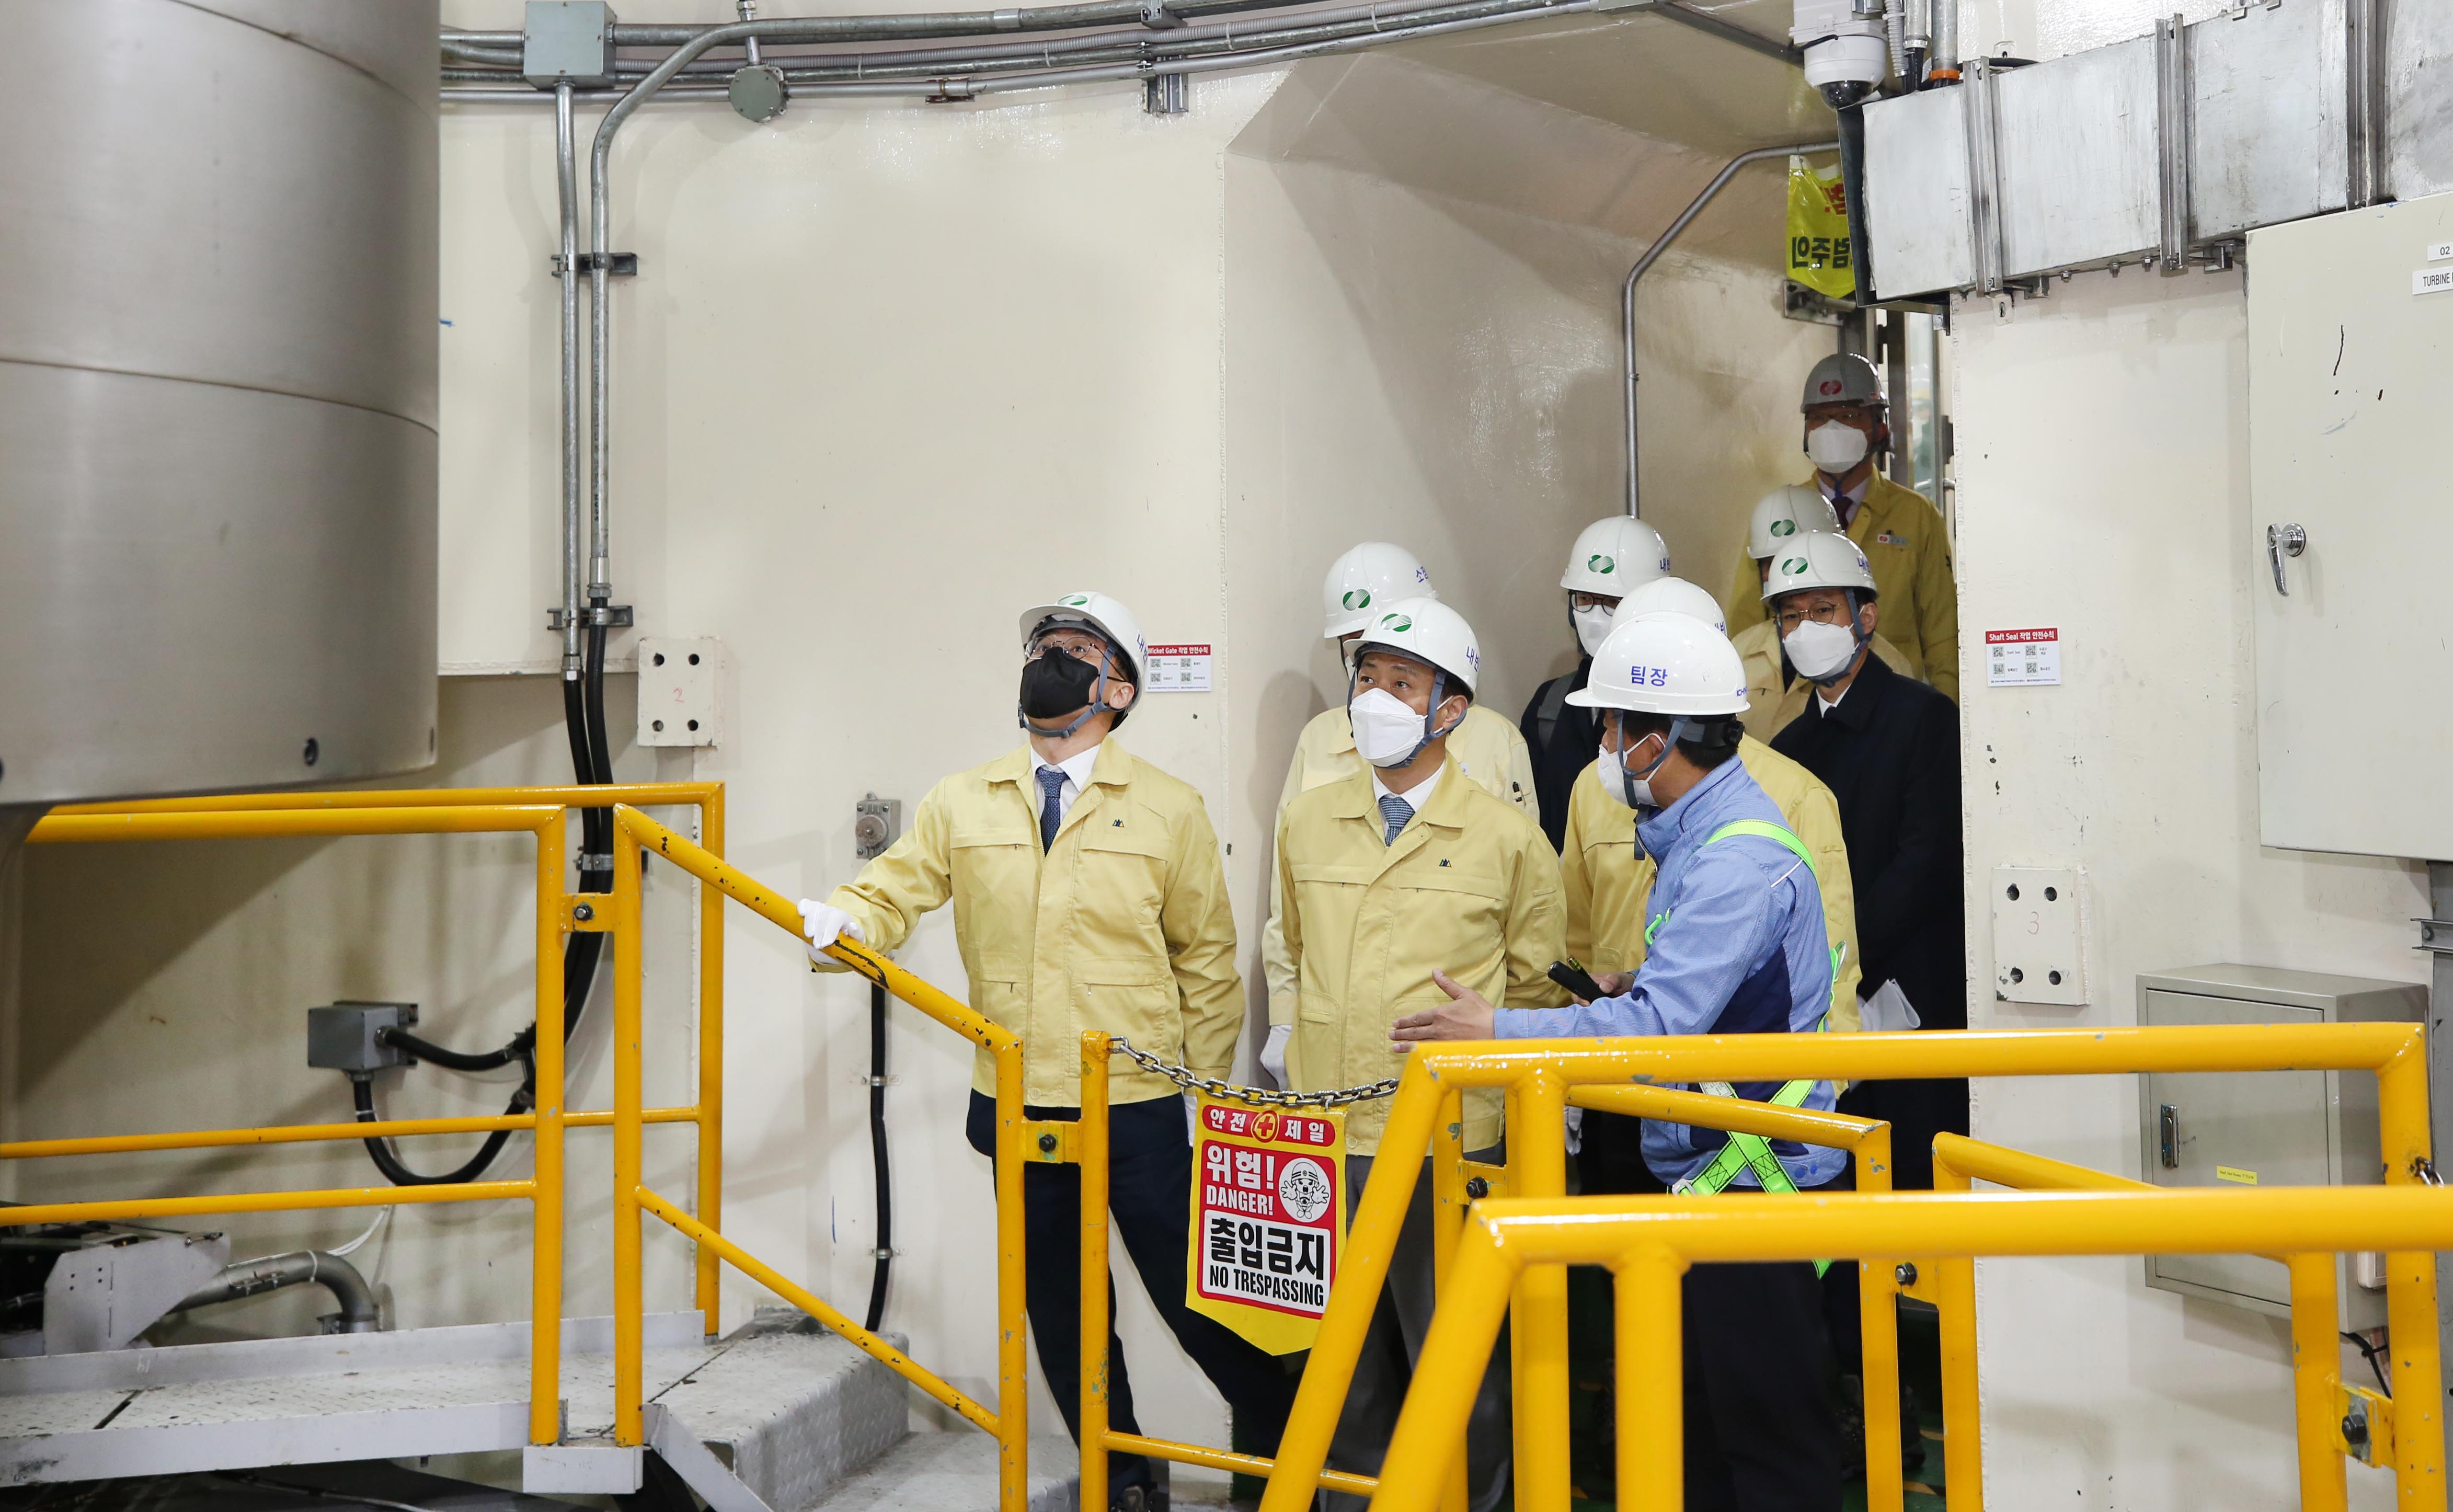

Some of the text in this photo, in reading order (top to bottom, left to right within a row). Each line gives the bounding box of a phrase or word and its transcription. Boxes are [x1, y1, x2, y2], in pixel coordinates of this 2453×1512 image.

[2440, 246, 2450, 256] 02
[2423, 272, 2450, 288] TURBINE
[1989, 633, 2004, 642] Shaft
[2020, 632, 2031, 640] 작업
[2032, 630, 2055, 639] 안전수칙
[1631, 666, 1668, 686] 팀장
[673, 687, 685, 703] 2
[2027, 911, 2039, 935] 3
[1210, 1108, 1325, 1143] 안전 제일
[1206, 1145, 1275, 1190] 위험!
[1206, 1185, 1274, 1216] DANGER!
[1210, 1218, 1324, 1280] 출입금지
[1209, 1265, 1324, 1307] NO TRESPASSING
